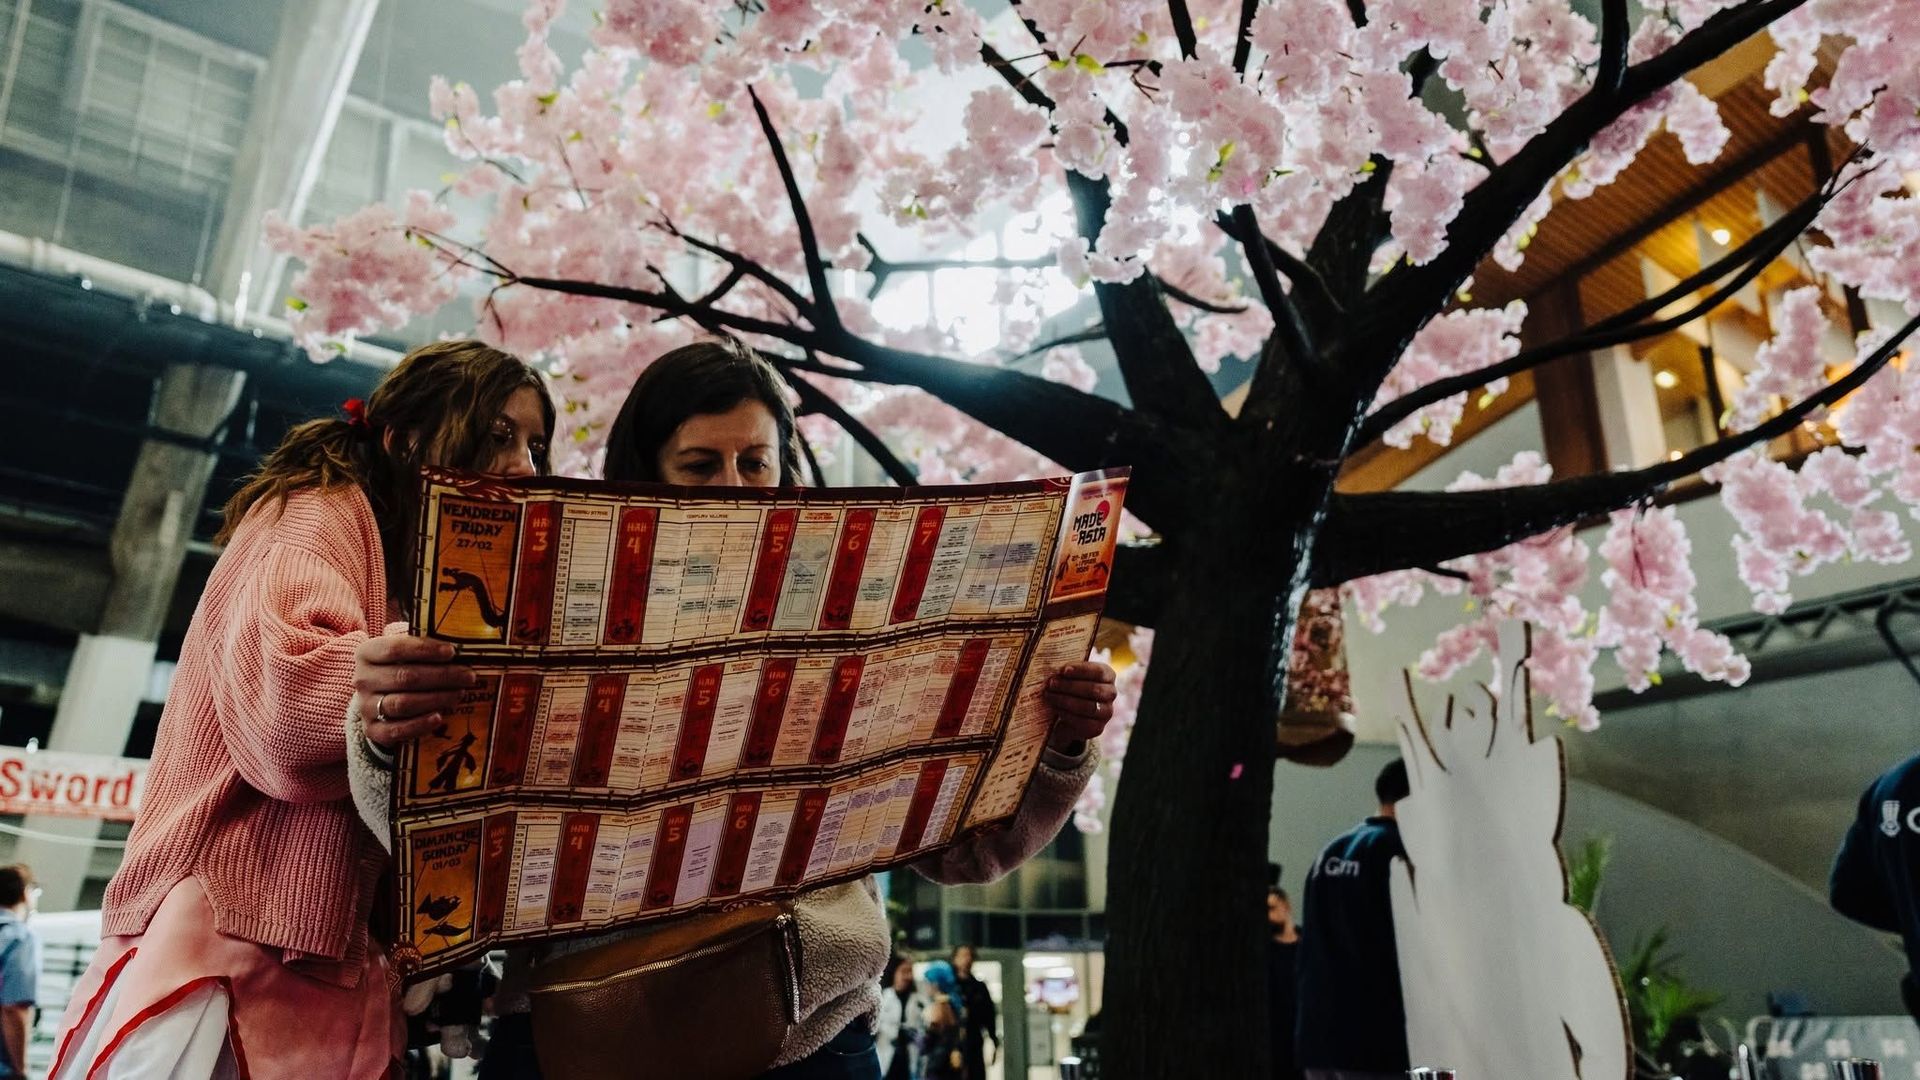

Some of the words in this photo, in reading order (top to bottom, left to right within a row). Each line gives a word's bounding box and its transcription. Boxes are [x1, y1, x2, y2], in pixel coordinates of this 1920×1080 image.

[443, 503, 516, 523] VENDREDI
[451, 520, 505, 538] FRIDAY
[1073, 512, 1104, 532] MADE
[456, 538, 493, 550] 27/02
[532, 531, 548, 551] 3
[848, 534, 861, 551] 6
[920, 530, 934, 546] 7
[1077, 527, 1107, 545] ASIA
[626, 536, 641, 554] 4
[770, 536, 785, 553] 5
[768, 682, 781, 697] 6
[840, 678, 853, 692] 7
[509, 697, 525, 713] 3
[597, 698, 611, 713] 4
[696, 690, 711, 706] 5
[0, 758, 135, 807] Sword
[735, 816, 748, 830] 6
[804, 809, 817, 822] 7
[414, 828, 479, 849] DIMANCHE
[570, 835, 583, 850] 4
[667, 828, 682, 843] 5
[422, 841, 471, 861] SUNDAY
[490, 840, 504, 858] 3
[432, 858, 461, 870] 01/03
